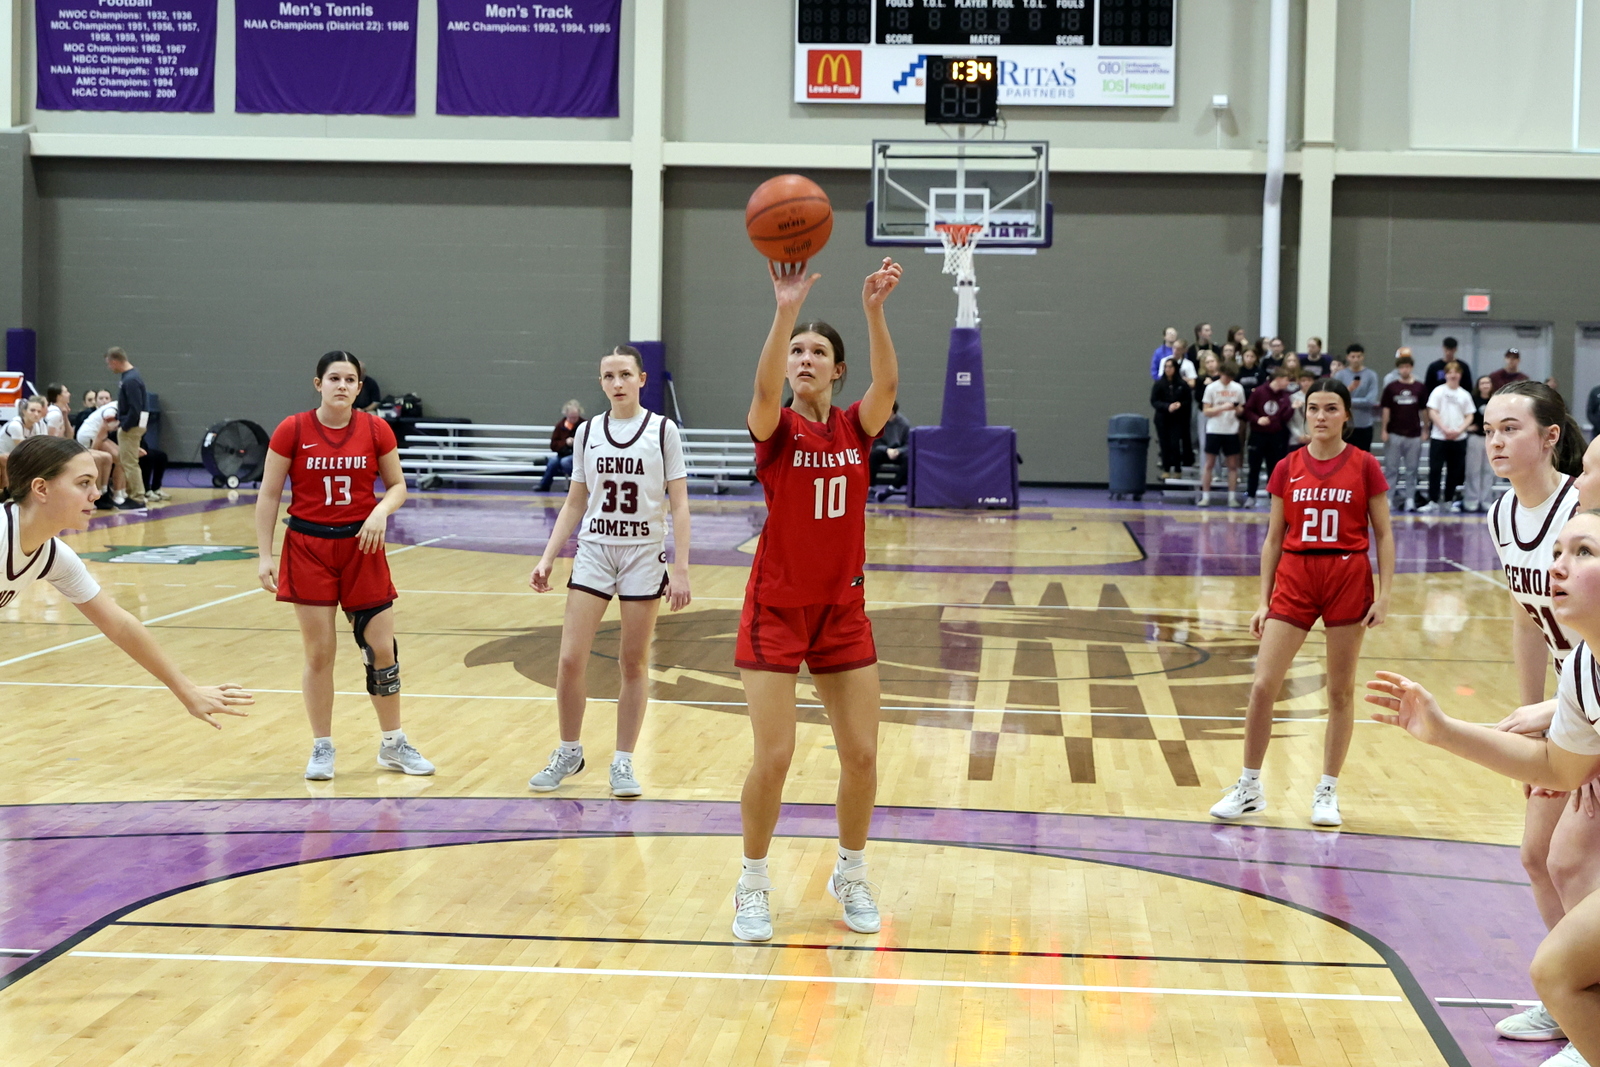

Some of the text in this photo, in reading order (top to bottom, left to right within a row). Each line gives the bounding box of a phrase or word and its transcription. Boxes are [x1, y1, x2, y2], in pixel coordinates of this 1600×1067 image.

[59, 9, 88, 19] NWOC
[90, 10, 142, 21] Champions:
[279, 2, 373, 17] Men's Tennis
[486, 4, 573, 19] Men's Track
[51, 21, 71, 30] MOL
[73, 21, 125, 31] Champions:
[244, 19, 268, 29] NAIA
[270, 19, 324, 31] Champions
[326, 20, 364, 32] (District
[366, 21, 384, 33] 22):
[447, 21, 471, 32] AMC
[473, 22, 530, 34] Champions:
[885, 34, 1085, 46] SCORE MATCH SCORE
[64, 43, 85, 53] MOC
[87, 44, 139, 54] Champions:
[100, 55, 152, 66] Champions:
[50, 65, 72, 74] NAIA
[74, 65, 110, 75] National
[112, 66, 150, 77] Playoffs:
[952, 60, 992, 82] 1:34
[76, 77, 96, 86] AMC
[98, 77, 150, 88] Champions:
[72, 88, 98, 97] HCAC
[100, 88, 152, 99] Champions:
[809, 85, 860, 96] Lewis Family
[1006, 88, 1075, 99] PARTNERS
[306, 456, 367, 470] BELLEVUE
[793, 448, 862, 468] BELLEVUE
[596, 457, 645, 475] GENOA
[322, 475, 352, 506] 13
[601, 479, 639, 515] 33
[813, 475, 847, 520] 10
[1293, 487, 1353, 504] BELLEVUE
[589, 518, 650, 537] COMETS
[1301, 507, 1339, 543] 20
